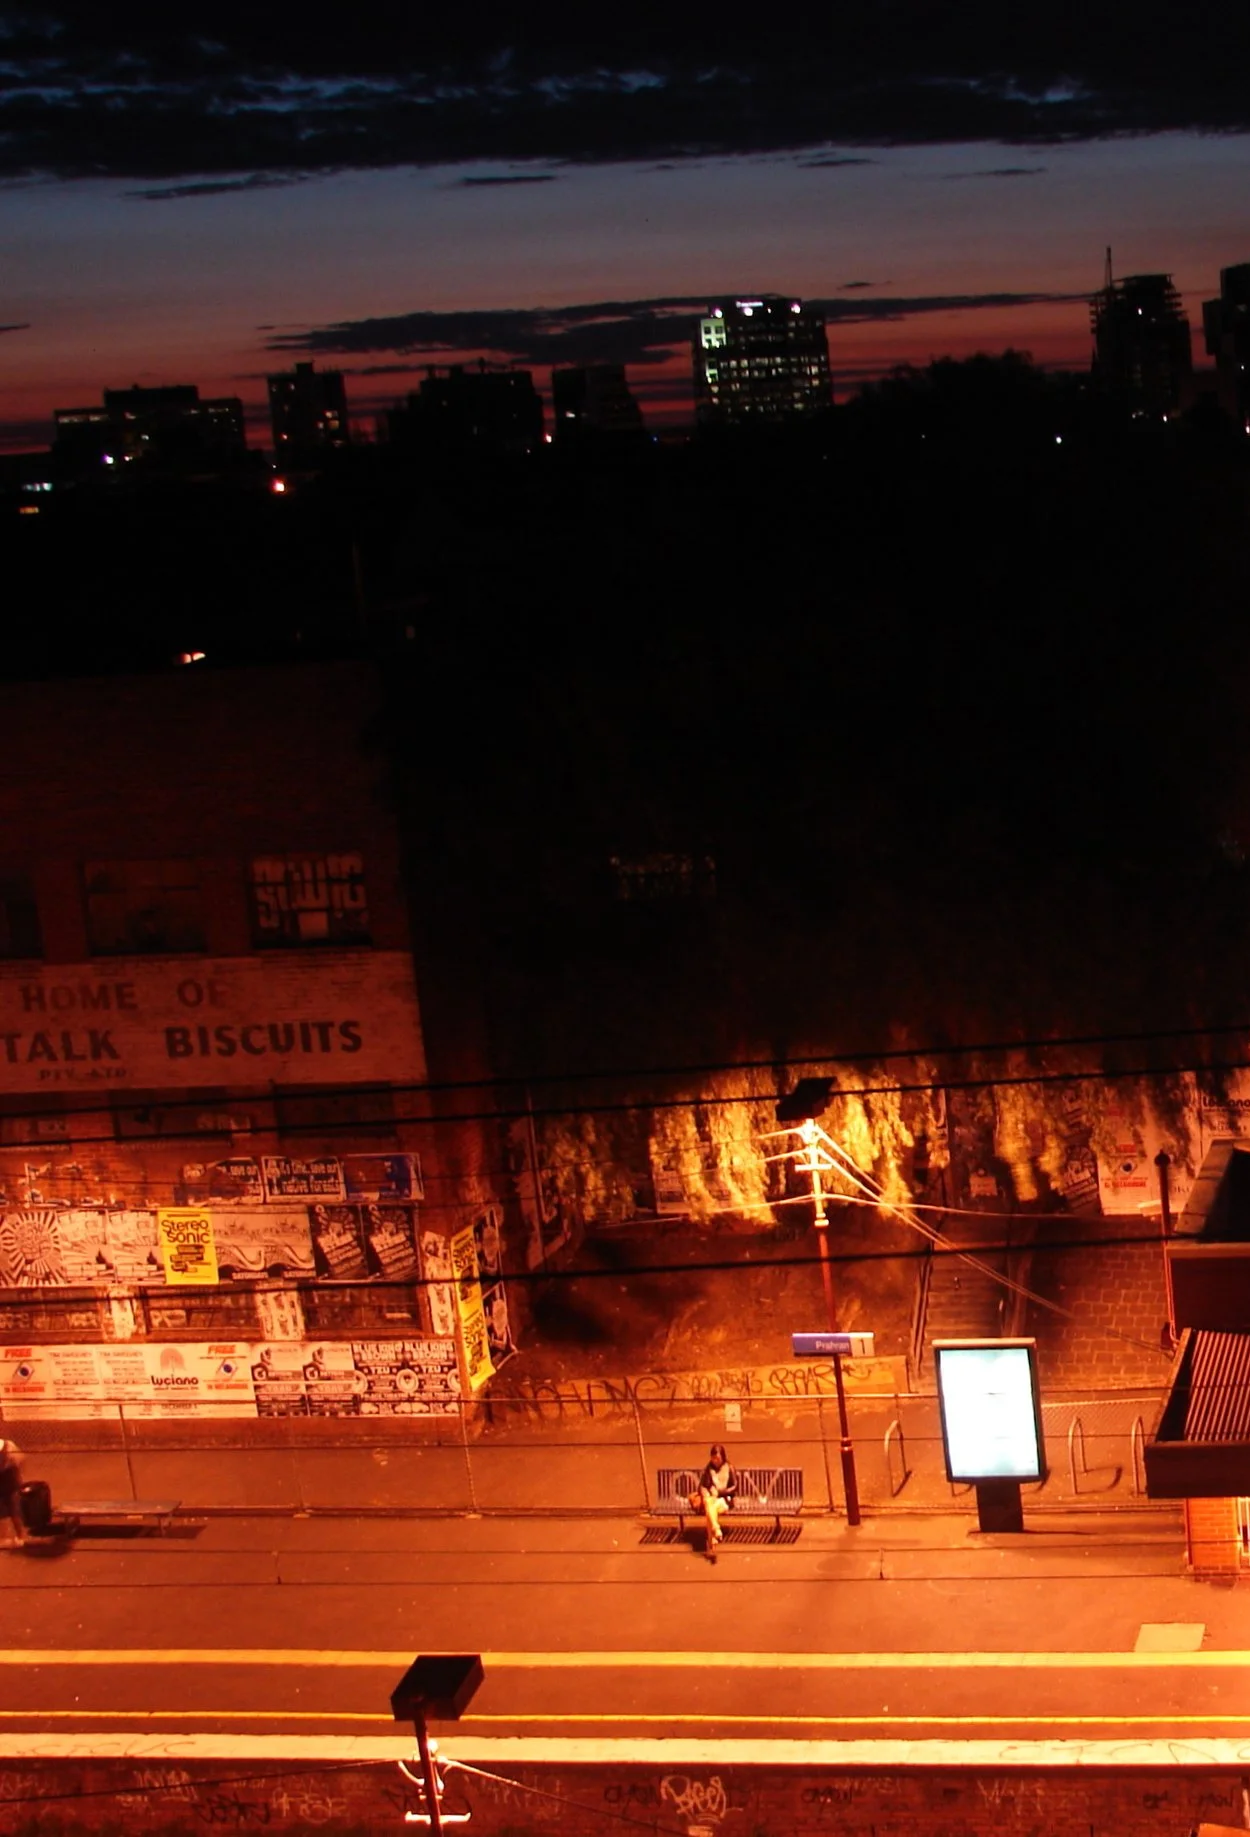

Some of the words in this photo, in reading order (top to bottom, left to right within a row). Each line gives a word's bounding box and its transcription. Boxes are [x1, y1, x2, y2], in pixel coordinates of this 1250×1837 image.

[19, 980, 139, 1012] HOME
[163, 1019, 364, 1059] BISCUITS
[161, 1219, 209, 1233] Stereo
[815, 1340, 850, 1351] Prahran
[858, 1338, 866, 1355] 1
[151, 1374, 200, 1386] luciano
